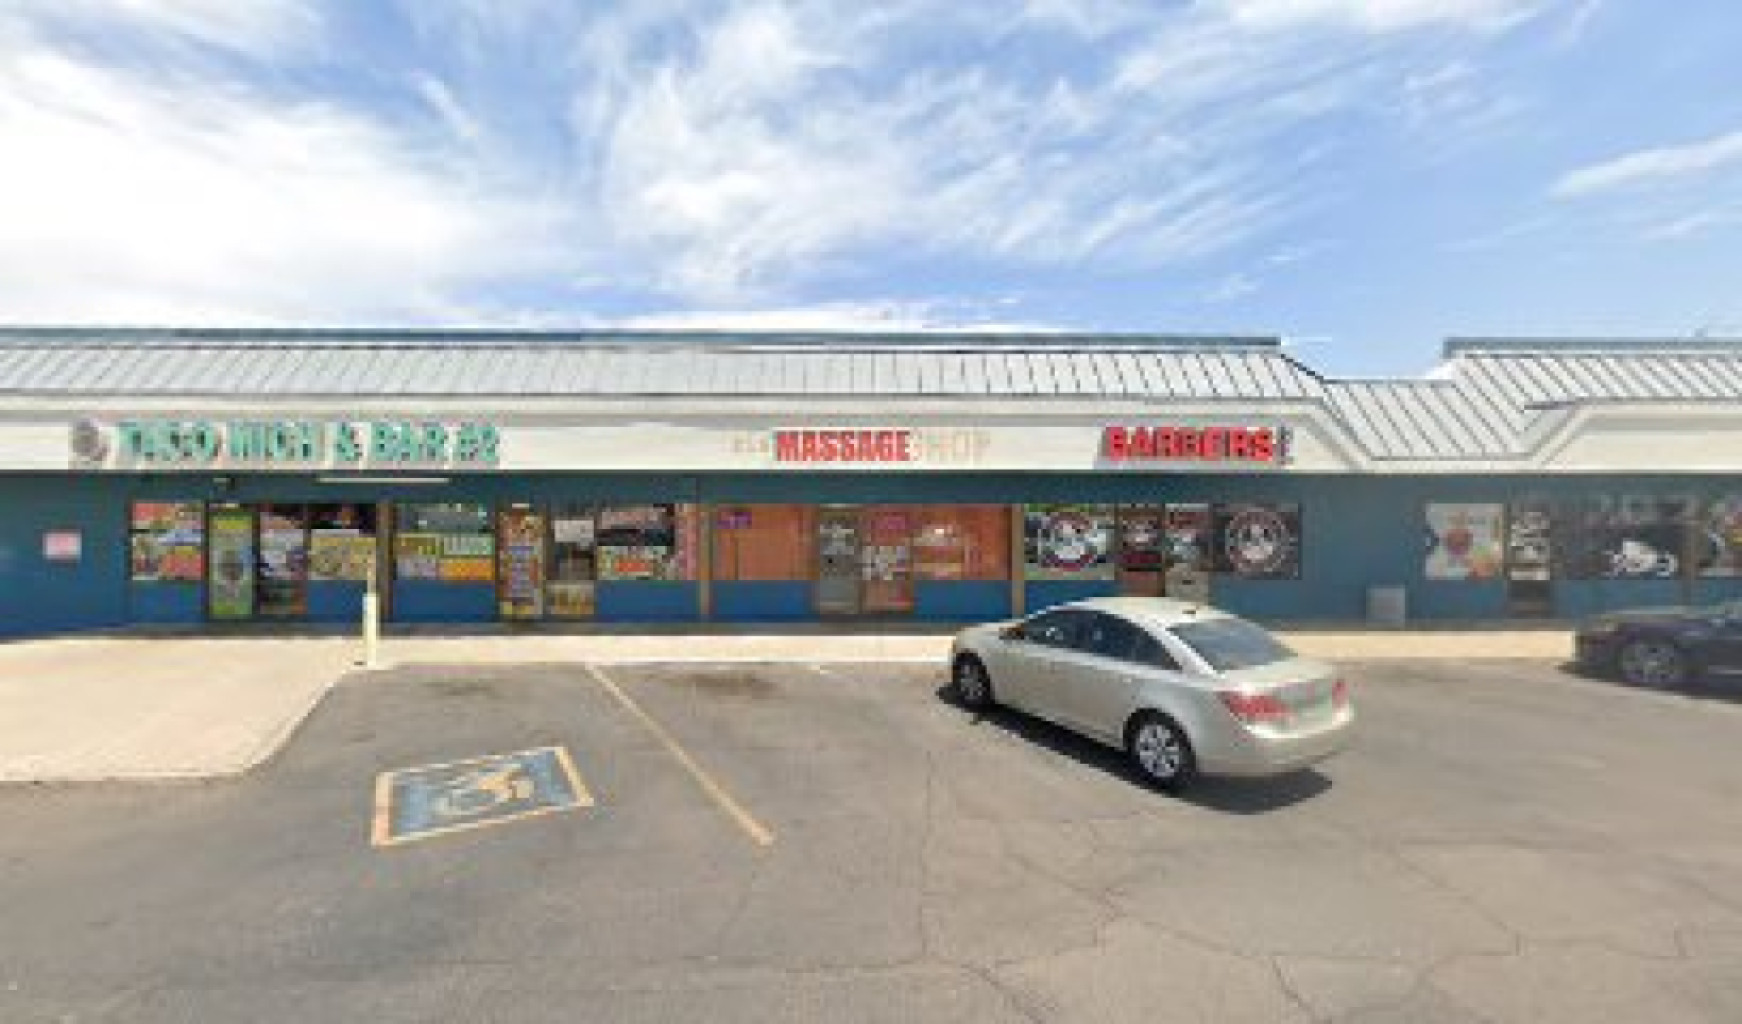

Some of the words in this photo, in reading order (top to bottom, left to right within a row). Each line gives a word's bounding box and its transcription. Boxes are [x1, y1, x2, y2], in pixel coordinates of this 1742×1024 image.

[118, 421, 219, 462] TACO
[334, 422, 363, 462] &
[369, 421, 449, 463] BAR
[455, 423, 500, 463] #2
[774, 430, 910, 463] MASSAGE
[1104, 426, 1275, 463] BARBERS
